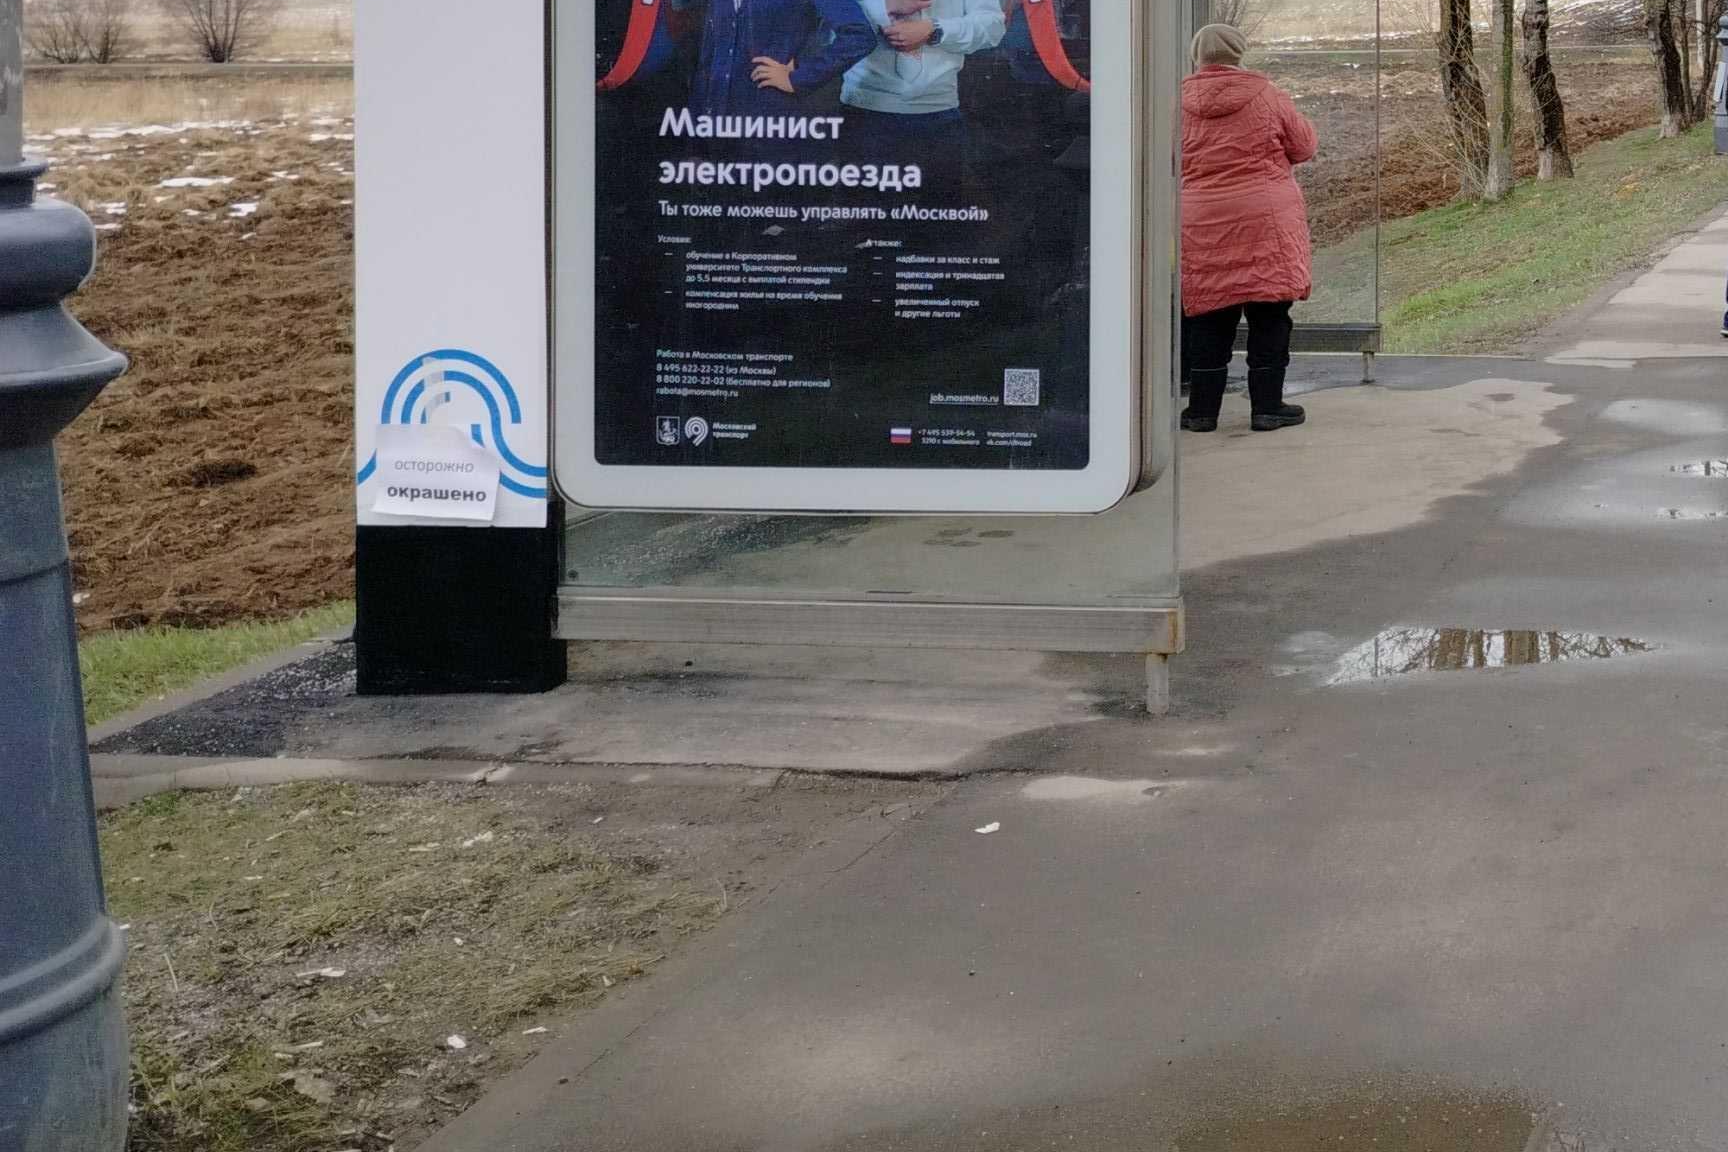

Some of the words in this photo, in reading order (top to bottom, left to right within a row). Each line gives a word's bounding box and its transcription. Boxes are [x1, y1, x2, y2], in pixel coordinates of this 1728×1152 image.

[659, 108, 844, 139] Машинист
[658, 160, 921, 192] электропоезда
[658, 201, 678, 216] Ты
[682, 203, 722, 218] тоже
[727, 204, 798, 218] можешь
[802, 206, 886, 222] управлять
[891, 205, 989, 221] «Москвой»
[656, 350, 685, 359] Работа
[656, 364, 662, 372] 8
[664, 364, 681, 372] 495
[682, 364, 724, 373] 622-22-22
[664, 376, 681, 384] 800
[682, 376, 724, 385] 220-22-02
[930, 393, 999, 404] job.mosmetro.ru
[394, 460, 474, 474] осторожно
[387, 486, 486, 502] окрашено
